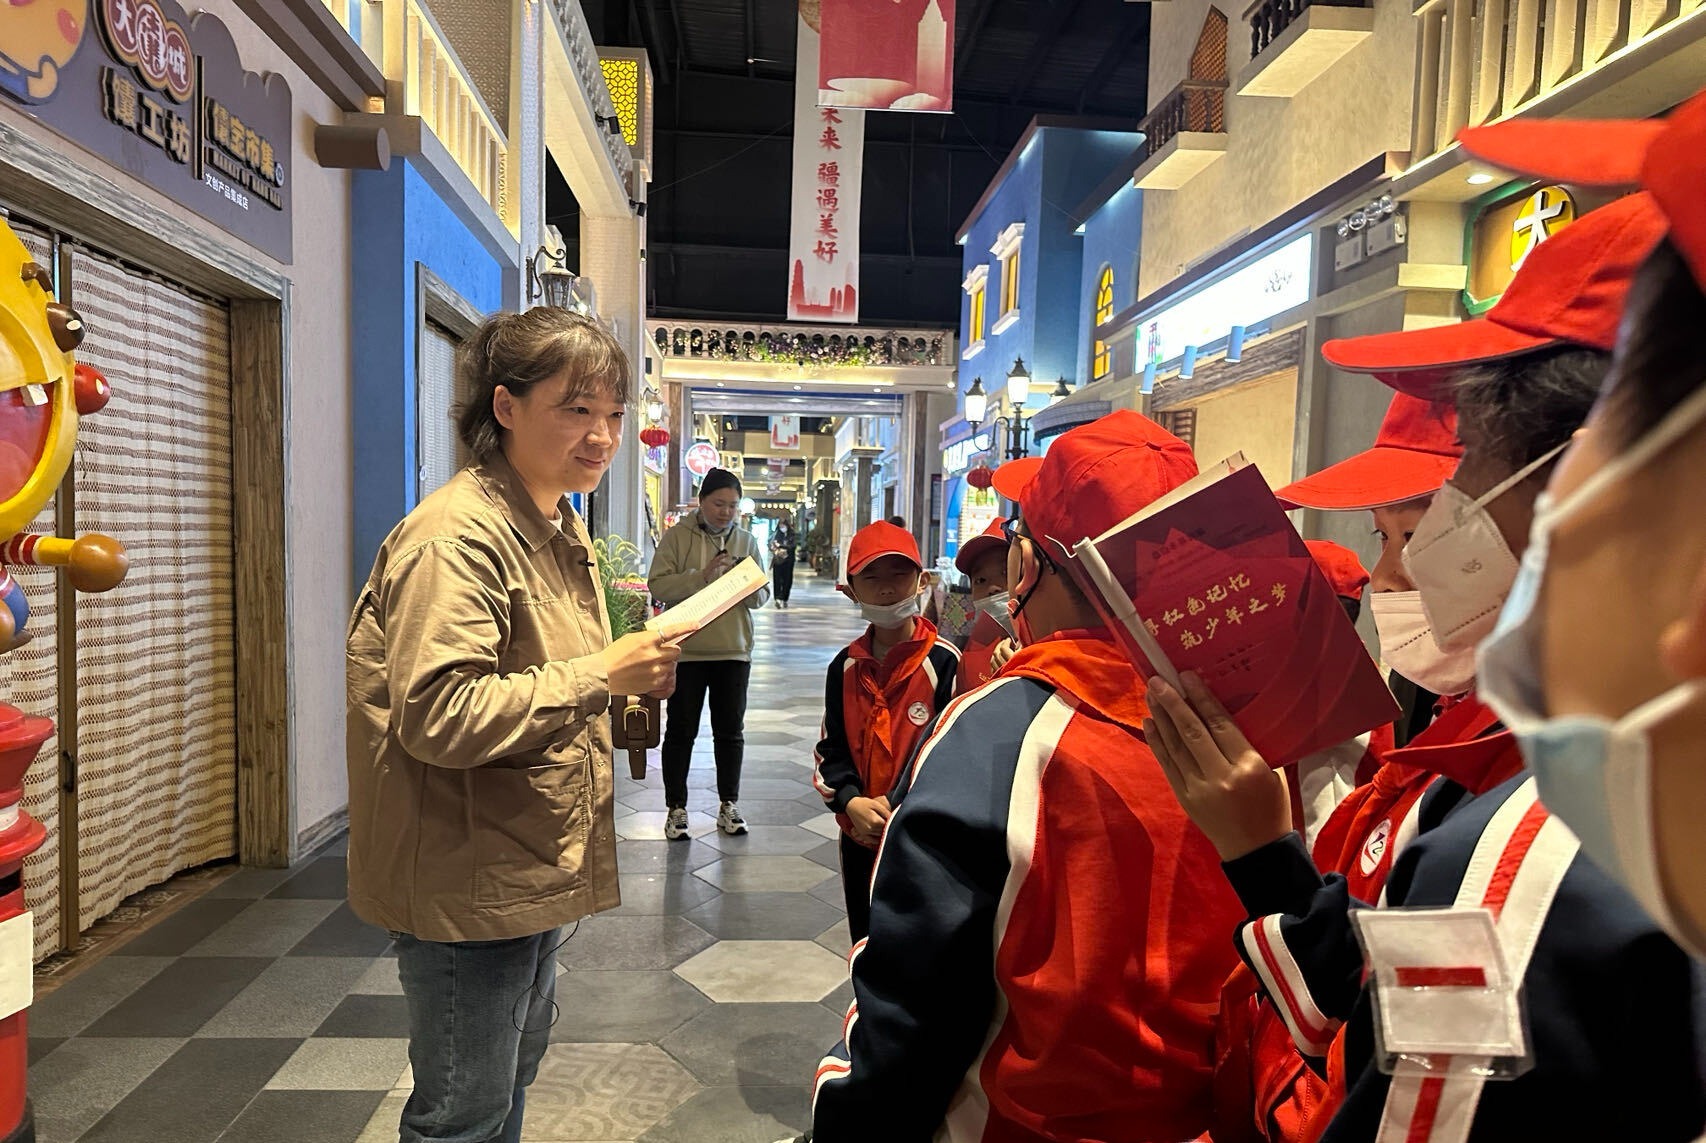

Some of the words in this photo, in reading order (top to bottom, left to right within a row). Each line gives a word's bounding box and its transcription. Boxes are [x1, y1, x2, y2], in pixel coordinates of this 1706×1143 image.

[205, 173, 249, 211] 文创产品集成店
[812, 161, 841, 265] 疆遇美好
[1180, 582, 1287, 650] 筑少年之梦
